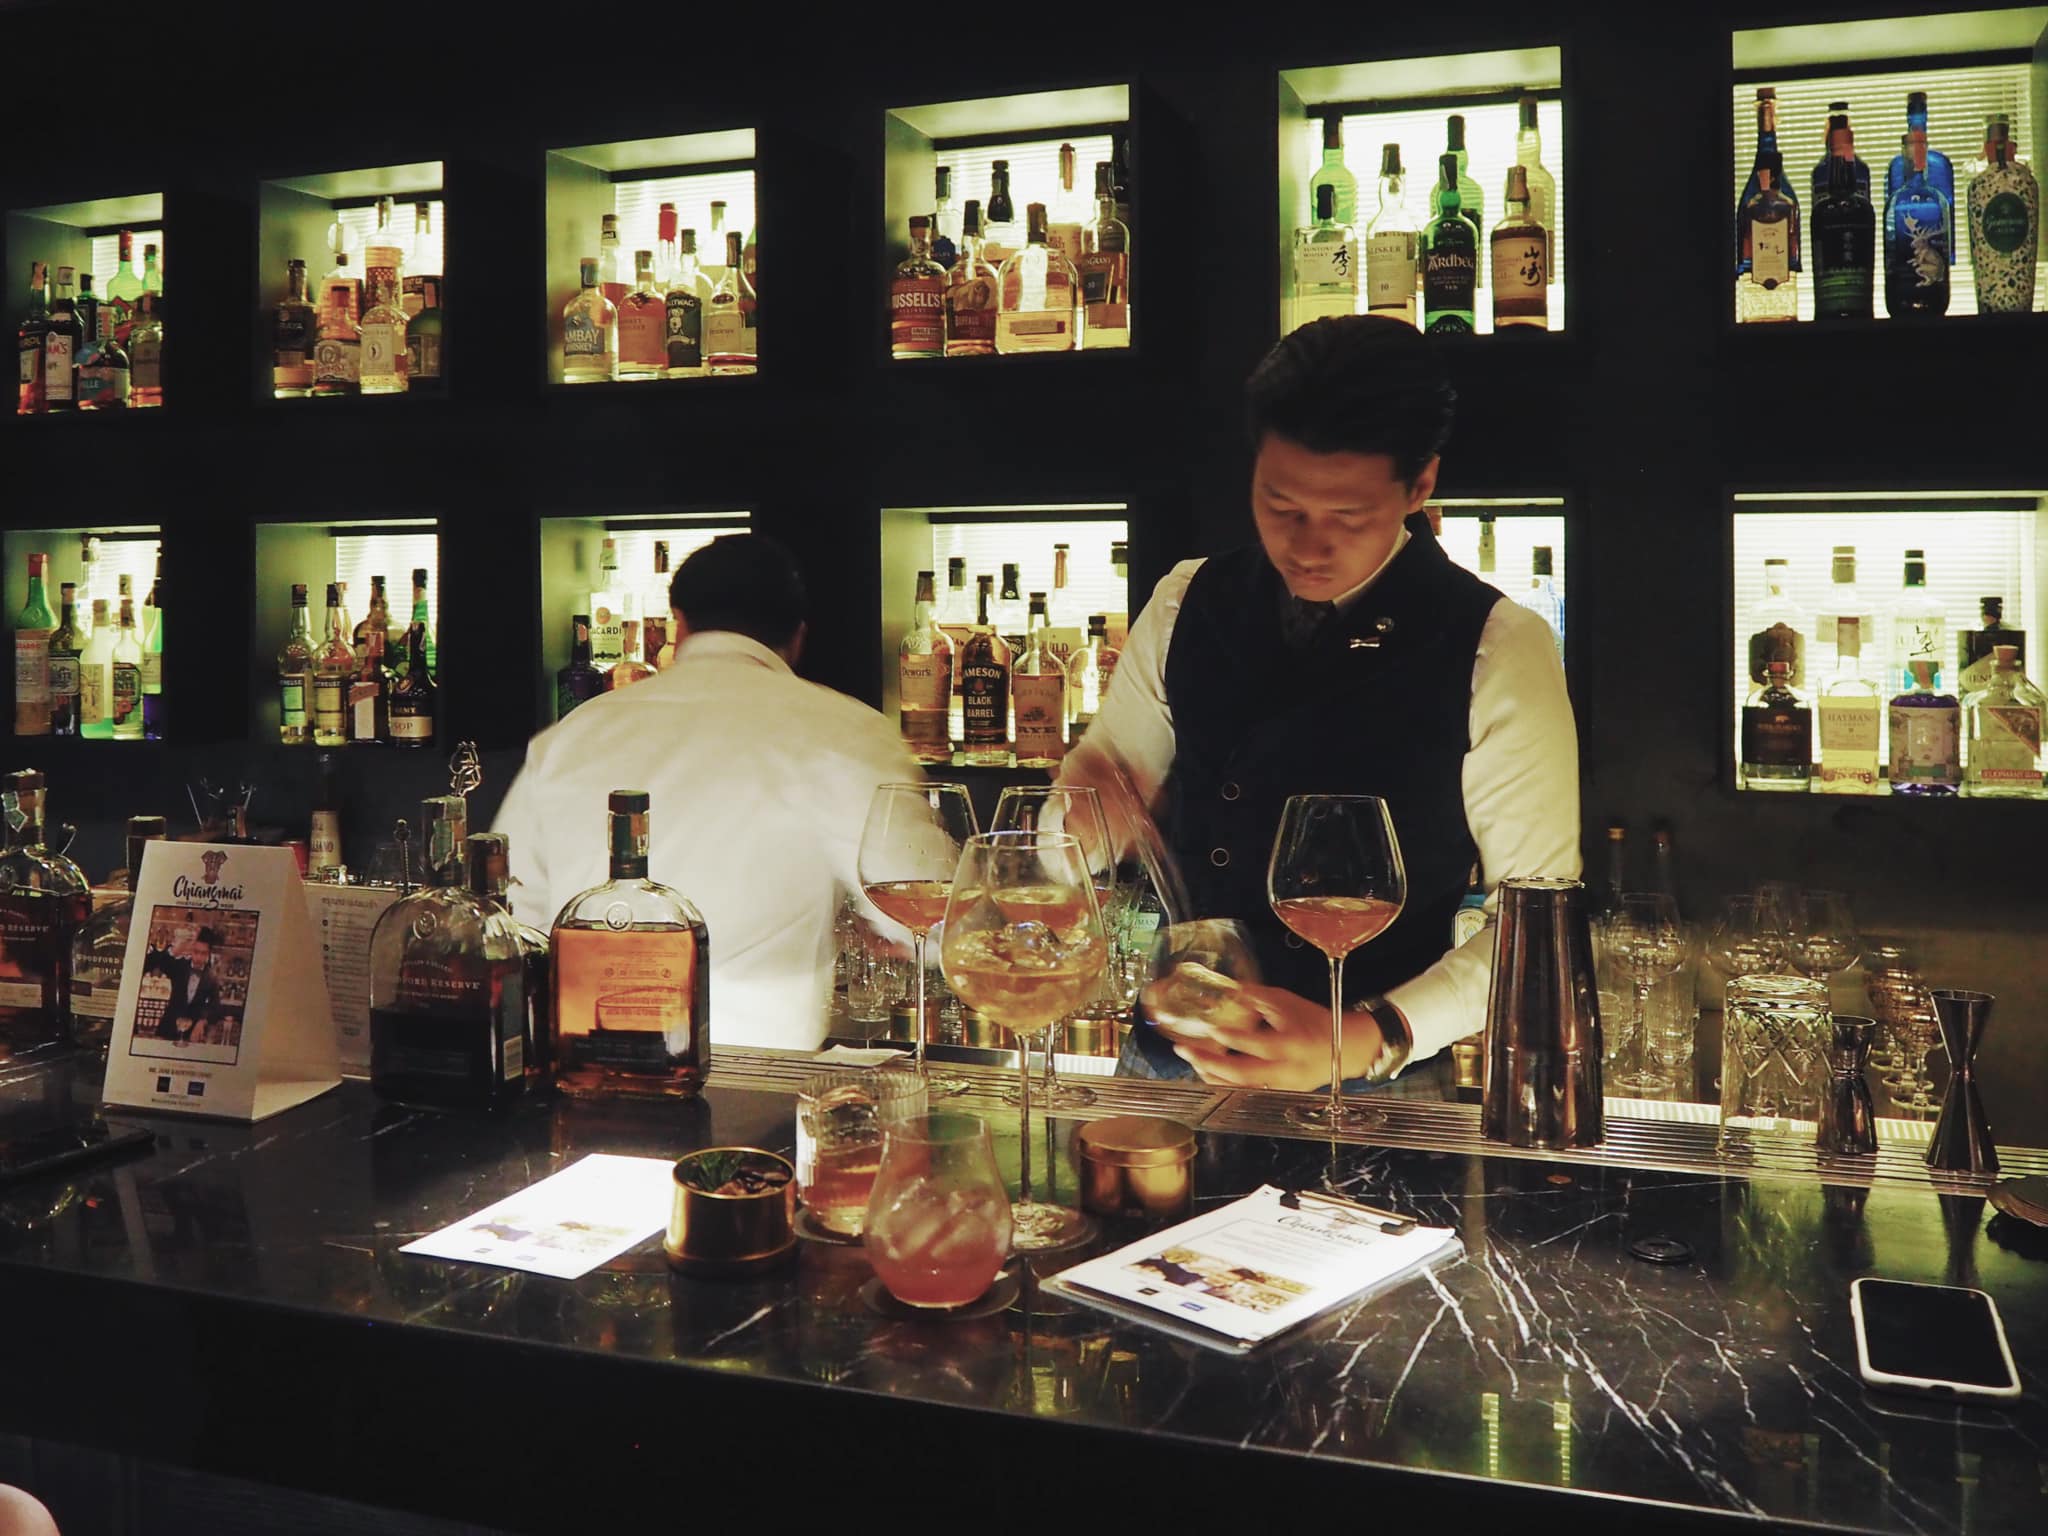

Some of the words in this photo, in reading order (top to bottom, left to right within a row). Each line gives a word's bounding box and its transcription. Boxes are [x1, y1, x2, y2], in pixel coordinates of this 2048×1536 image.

[565, 328, 600, 345] AMBAY
[968, 695, 993, 705] BLACK
[967, 708, 995, 718] BARREL
